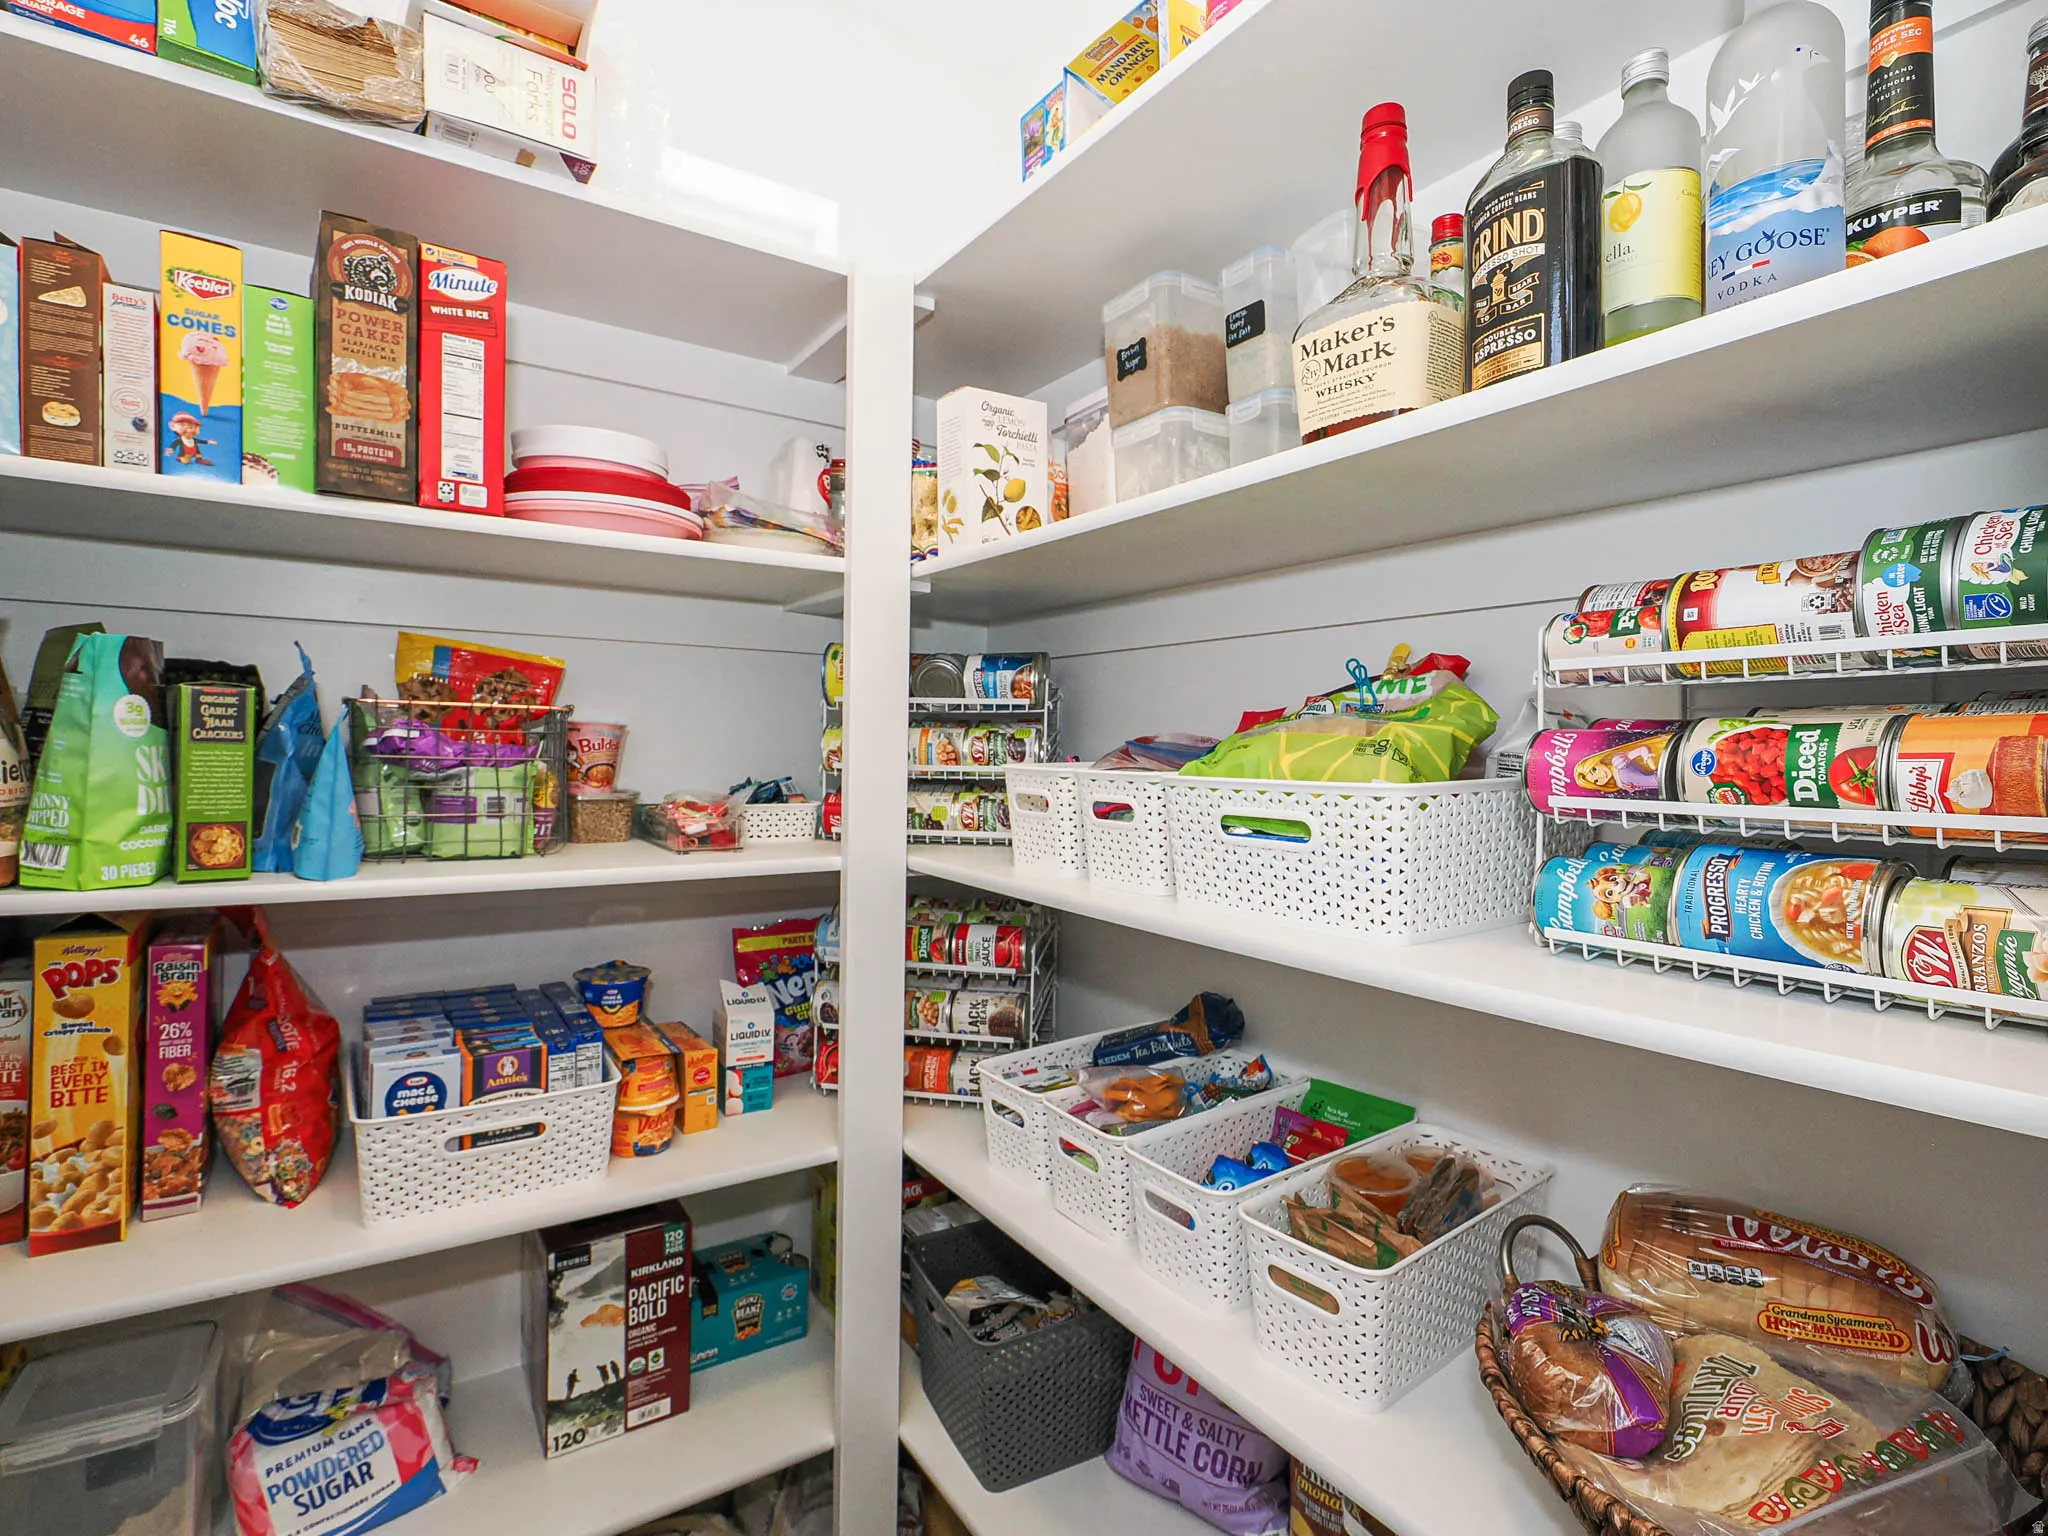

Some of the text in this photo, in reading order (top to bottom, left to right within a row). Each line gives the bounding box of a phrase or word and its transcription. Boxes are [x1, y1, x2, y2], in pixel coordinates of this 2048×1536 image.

[163, 18, 177, 35] 116
[128, 33, 150, 48] 46
[1870, 27, 1922, 57] RIPLE SEC
[1095, 38, 1151, 85] MANDARIN
[1108, 47, 1155, 87] ORANGES
[1883, 64, 1914, 79] BRAND
[562, 76, 577, 140] SOLO
[1876, 88, 1901, 103] TRUST
[1491, 191, 1538, 215] COFFEE BEANS
[1846, 199, 1943, 236] KUYPER
[1471, 207, 1546, 273] GRIND
[1512, 245, 1541, 258] SHOT
[1735, 228, 1830, 262] GOOSE
[174, 270, 233, 297] Keebler
[430, 272, 498, 294] Minute
[1512, 277, 1534, 293] BEAN
[1716, 272, 1778, 301] VODKA
[344, 284, 398, 312] KODIAK
[1505, 298, 1527, 311] BAR
[335, 308, 405, 334] POWER
[430, 305, 489, 320] WHITE RICE
[1480, 314, 1491, 324] TO
[166, 313, 237, 339] CONES
[338, 322, 403, 346] CAKES
[1299, 315, 1396, 362] Maker's
[1483, 325, 1517, 346] DOUBLE
[1321, 341, 1395, 377] Mark
[1474, 328, 1537, 365] ESPRESSO
[1315, 372, 1378, 399] WHISKY
[981, 400, 1015, 417] Organic
[334, 422, 403, 440] BUTTERMILK
[357, 444, 394, 459] PROTEIN
[1974, 514, 2002, 555] Chicken
[1995, 519, 2015, 541] Sea
[2018, 525, 2036, 554] CHUNK
[1897, 563, 1906, 587] water
[1912, 586, 1926, 609] LIGHT
[1893, 603, 1910, 632] Sea
[126, 702, 144, 716] 3g
[199, 695, 240, 704] ORGANIC
[200, 704, 238, 716] GARLIC
[192, 728, 245, 740] CRACKERS
[1698, 750, 1712, 776] Kroger
[1791, 729, 1821, 802] Diced
[1817, 742, 1828, 786] TOMATOES
[1907, 763, 1936, 815] Libby's
[101, 864, 118, 881] 30
[1755, 862, 1776, 890] ROTINI
[1684, 869, 1700, 913] TRADITIONAL
[1709, 855, 1731, 936] PROGRESSO
[1733, 876, 1752, 915] HEARTY
[1749, 898, 1763, 941] CHICKEN
[918, 928, 929, 958] Diced
[981, 936, 992, 967] SAUCE
[1951, 942, 1960, 960] SINCE
[154, 961, 201, 974] Raisin
[1971, 923, 1988, 993] RBANZOS
[1997, 935, 2037, 1000] rganic
[41, 958, 122, 1000] POPS
[159, 972, 197, 984] Bran
[726, 997, 757, 1006] LIQUID
[61, 1021, 93, 1030] Sweet
[158, 1022, 193, 1039] 26%
[969, 1002, 981, 1035] LACK
[730, 1030, 760, 1041] LIQUID
[158, 1045, 192, 1059] FIBER
[1098, 1052, 1131, 1066] KEDEM
[1130, 1044, 1150, 1059] Tea
[50, 1072, 108, 1090] EVERY
[51, 1061, 109, 1076] BEST IN
[485, 1073, 529, 1089] Annie's
[50, 1087, 108, 1108] BITE
[396, 1085, 436, 1099] mac &
[664, 1229, 684, 1241] 120
[630, 1257, 684, 1279] KIRKLAND
[628, 1275, 685, 1307] PACIFIC
[628, 1299, 668, 1326] BOLD
[1771, 1305, 1894, 1332] Grandma Sycamore's
[1765, 1313, 1904, 1349] HOME MAID BREAD
[1139, 1383, 1245, 1451] SWEET & SALTY
[265, 1417, 374, 1478] PREMIUM CANE
[552, 1428, 587, 1452] 120
[1124, 1391, 1264, 1489] KETTLE CORN
[266, 1429, 385, 1505] POWDERED
[293, 1461, 375, 1517] SUGAR
